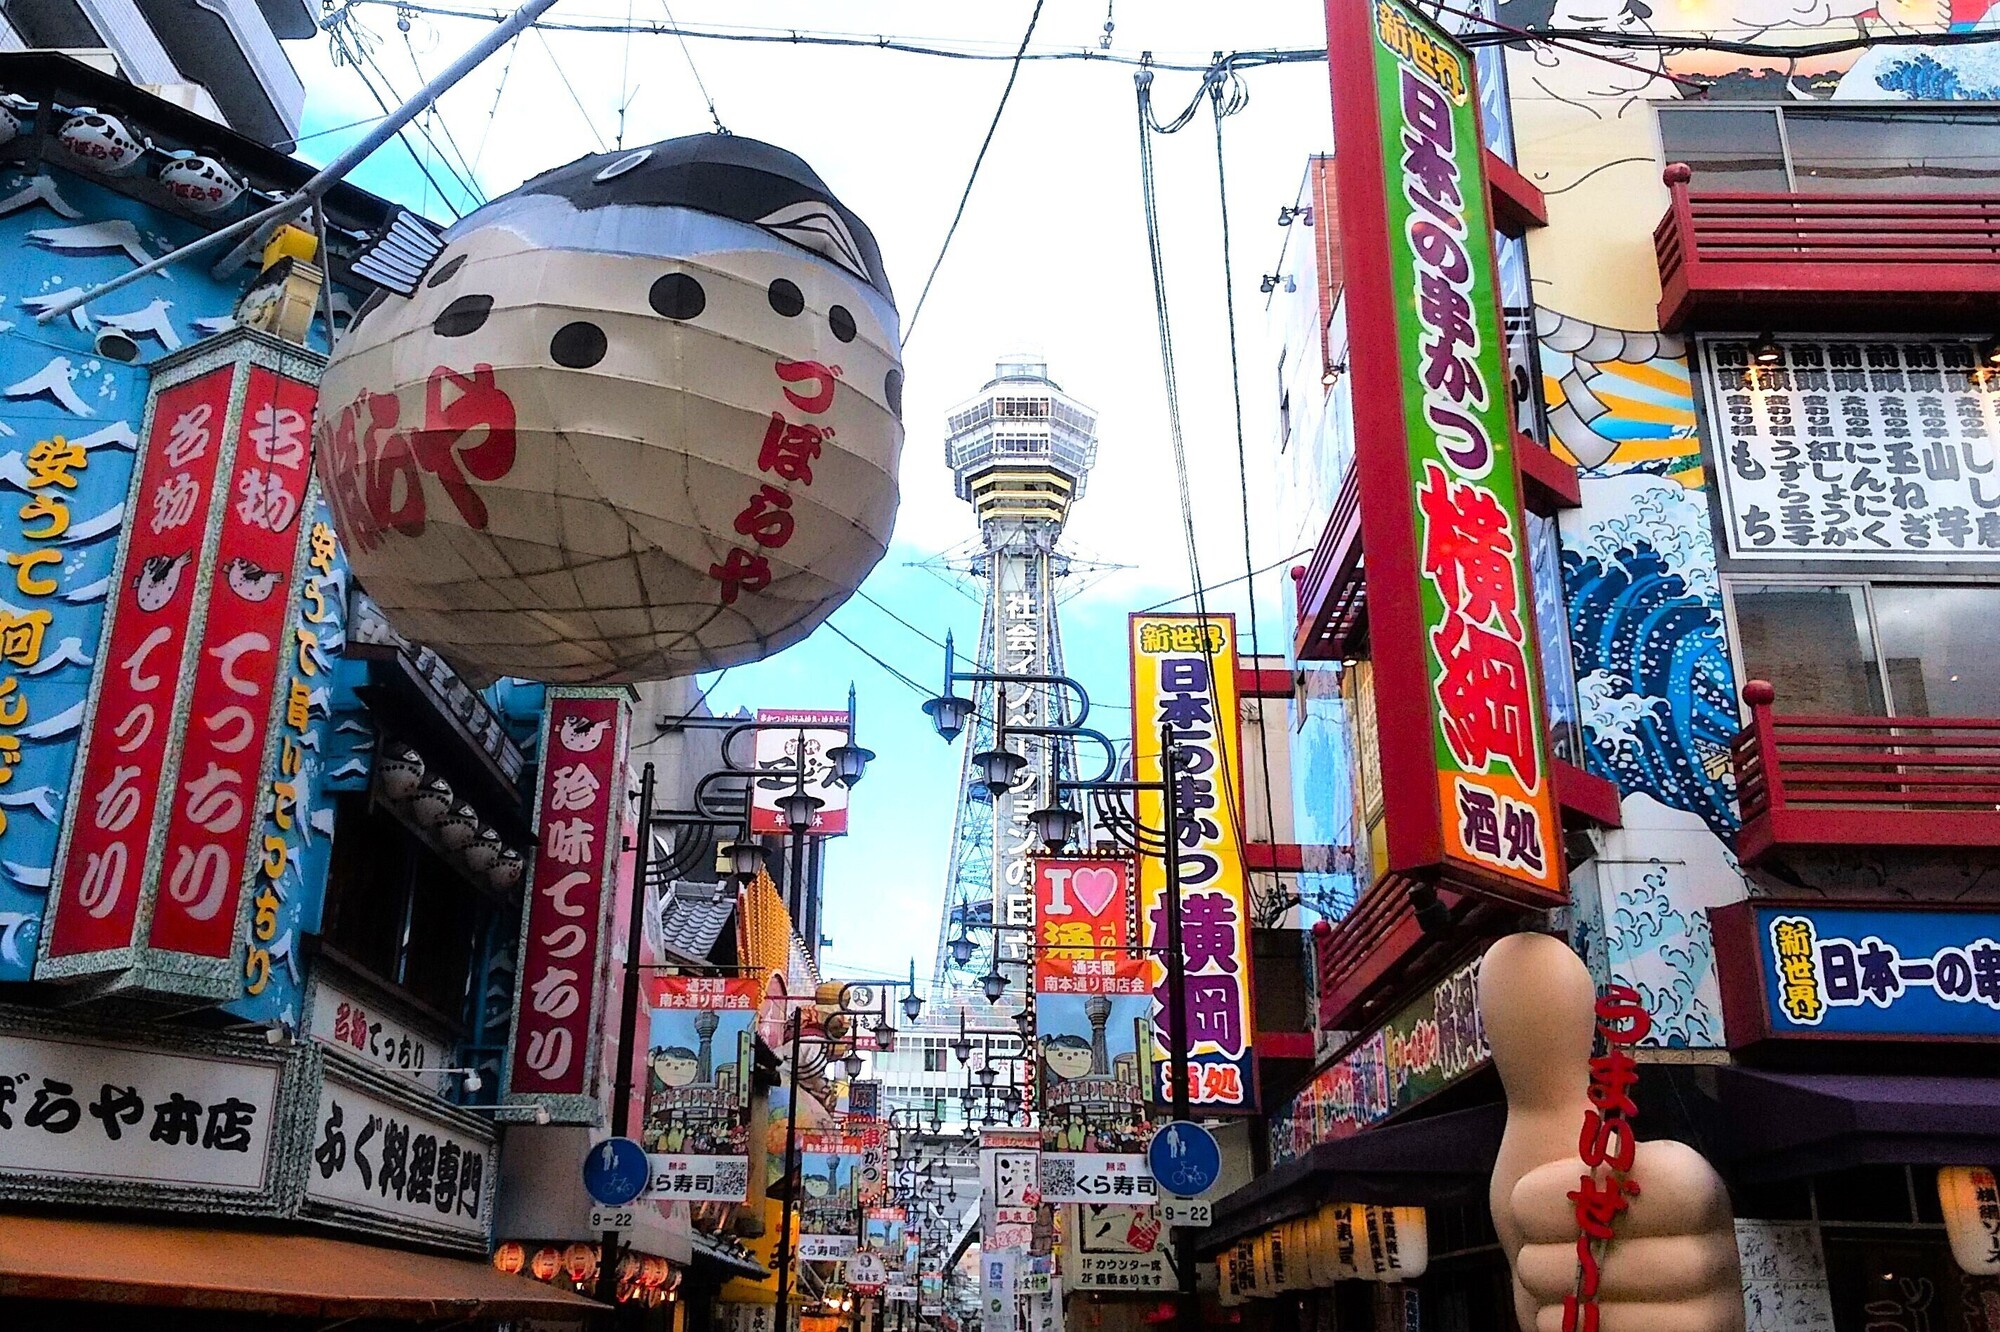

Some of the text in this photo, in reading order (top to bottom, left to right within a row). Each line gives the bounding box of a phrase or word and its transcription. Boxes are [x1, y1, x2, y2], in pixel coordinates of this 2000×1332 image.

[1378, 2, 1466, 101] 新世界
[318, 362, 517, 557] ぼらや
[1401, 68, 1539, 791] 日本一の串かつ 横綱
[708, 359, 842, 605] づぼらや
[1731, 440, 1777, 547] もち
[1770, 440, 1820, 548] うずら玉子
[1805, 440, 1859, 548] 紅しょうが
[1844, 442, 1892, 549] にんにく
[1884, 441, 1934, 549] 玉ねぎ
[1922, 441, 1974, 549] 山芋
[1140, 622, 1226, 654] 新世界
[774, 813, 825, 827] 年休
[1150, 657, 1242, 1056] 日本一の串かつ 横綱
[1461, 783, 1543, 871] 酒処
[1043, 867, 1073, 916] I
[659, 993, 752, 1009] 南本通り商店会
[685, 978, 727, 993] 通天閣
[1043, 975, 1145, 993] 南本通り商店会
[1071, 960, 1117, 975] 通天閣
[1776, 920, 1823, 1021] 新世界
[1820, 942, 2000, 1004] 日本一の串
[1163, 1062, 1240, 1101] 酒処
[315, 1099, 483, 1220] ふぐ料理専門
[863, 1127, 881, 1182] 串かつ
[1075, 1174, 1158, 1197] くら寿司
[799, 1244, 840, 1258] くら寿司
[1081, 1272, 1162, 1286] 2F 座敷あります
[1082, 1258, 1162, 1272] 1F カウンター席
